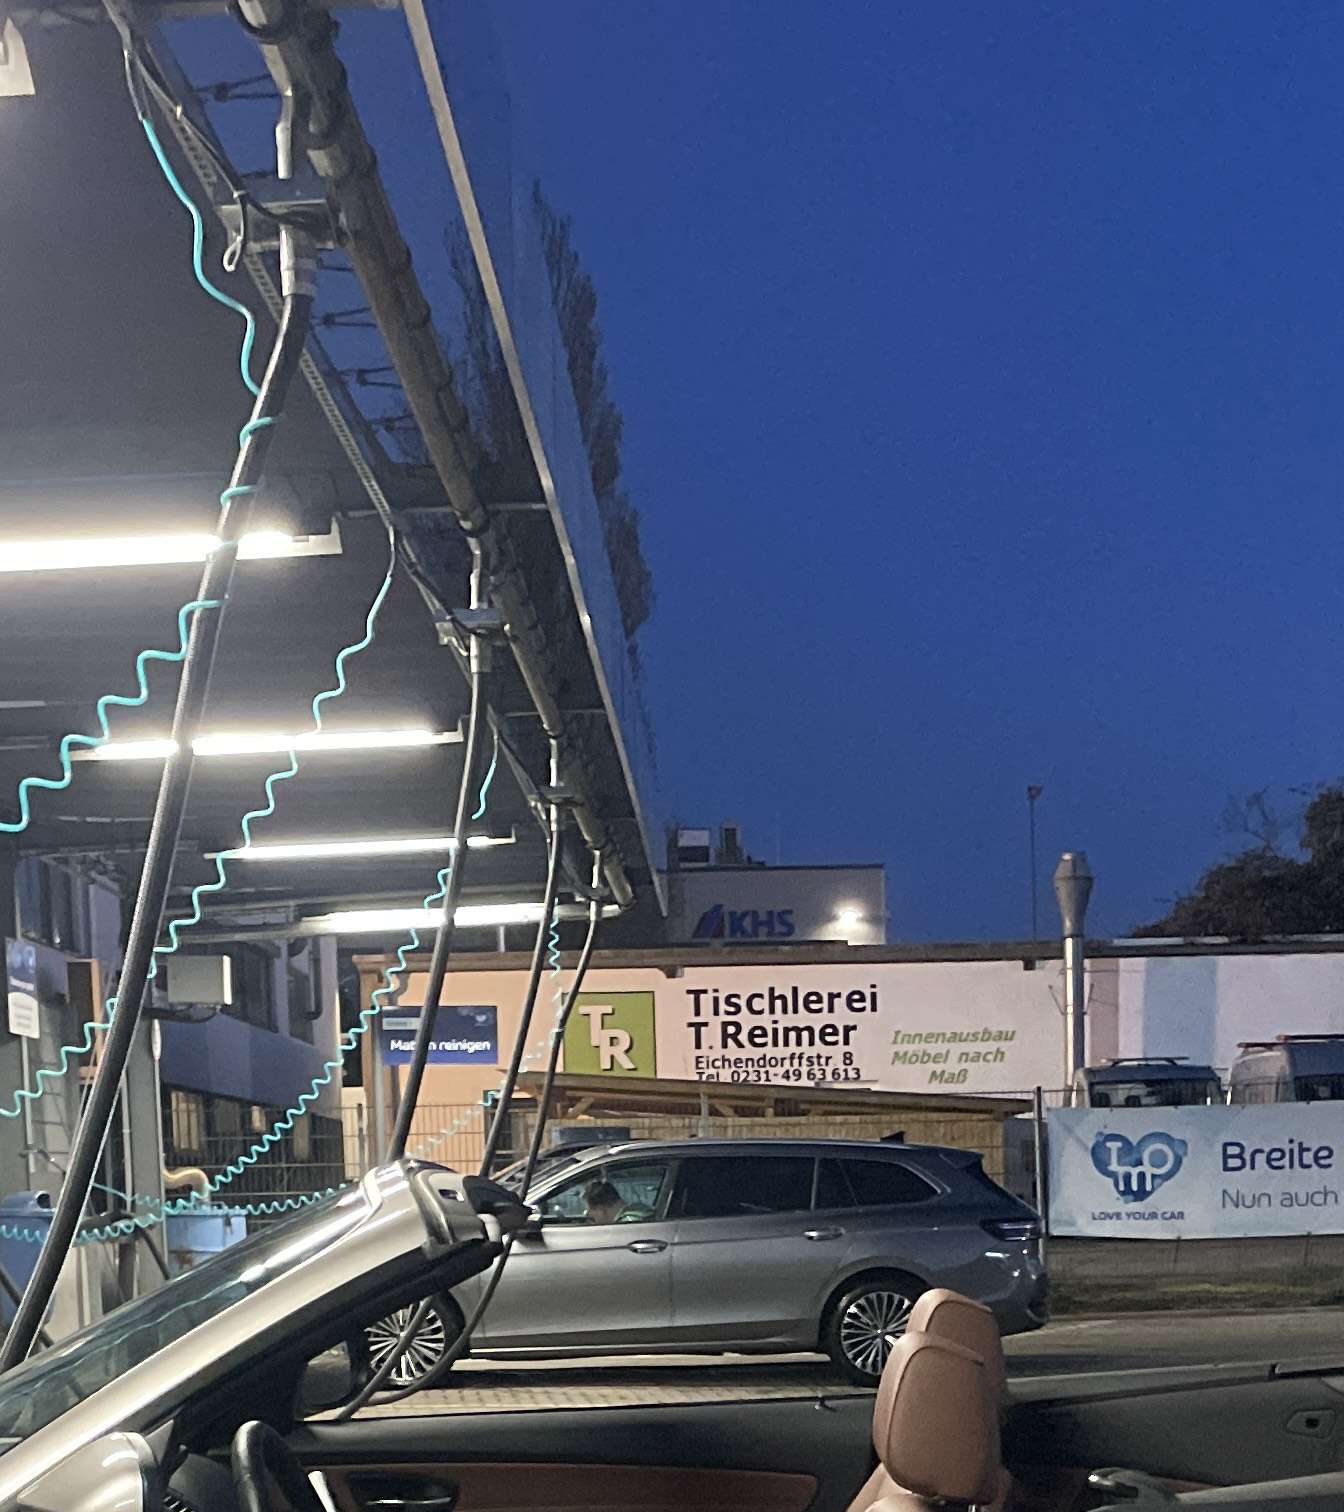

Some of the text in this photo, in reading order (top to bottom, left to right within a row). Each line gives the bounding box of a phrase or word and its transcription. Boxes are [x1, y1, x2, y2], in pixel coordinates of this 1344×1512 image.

[728, 909, 796, 938] KHS
[686, 984, 878, 1017] Tischlerei
[891, 1027, 1016, 1045] Innenausbau
[390, 1039, 491, 1054] Matn reinigen
[842, 1051, 854, 1066] 8
[890, 1047, 1006, 1066] Möbel nach
[806, 1067, 827, 1081] 63
[831, 1067, 861, 1081] 613
[927, 1068, 969, 1084] Maß
[1221, 1138, 1334, 1172] Breite
[1222, 1188, 1272, 1209] Nun
[1279, 1185, 1339, 1208] auch
[1091, 1211, 1185, 1221] LOVE YOUR CAR
